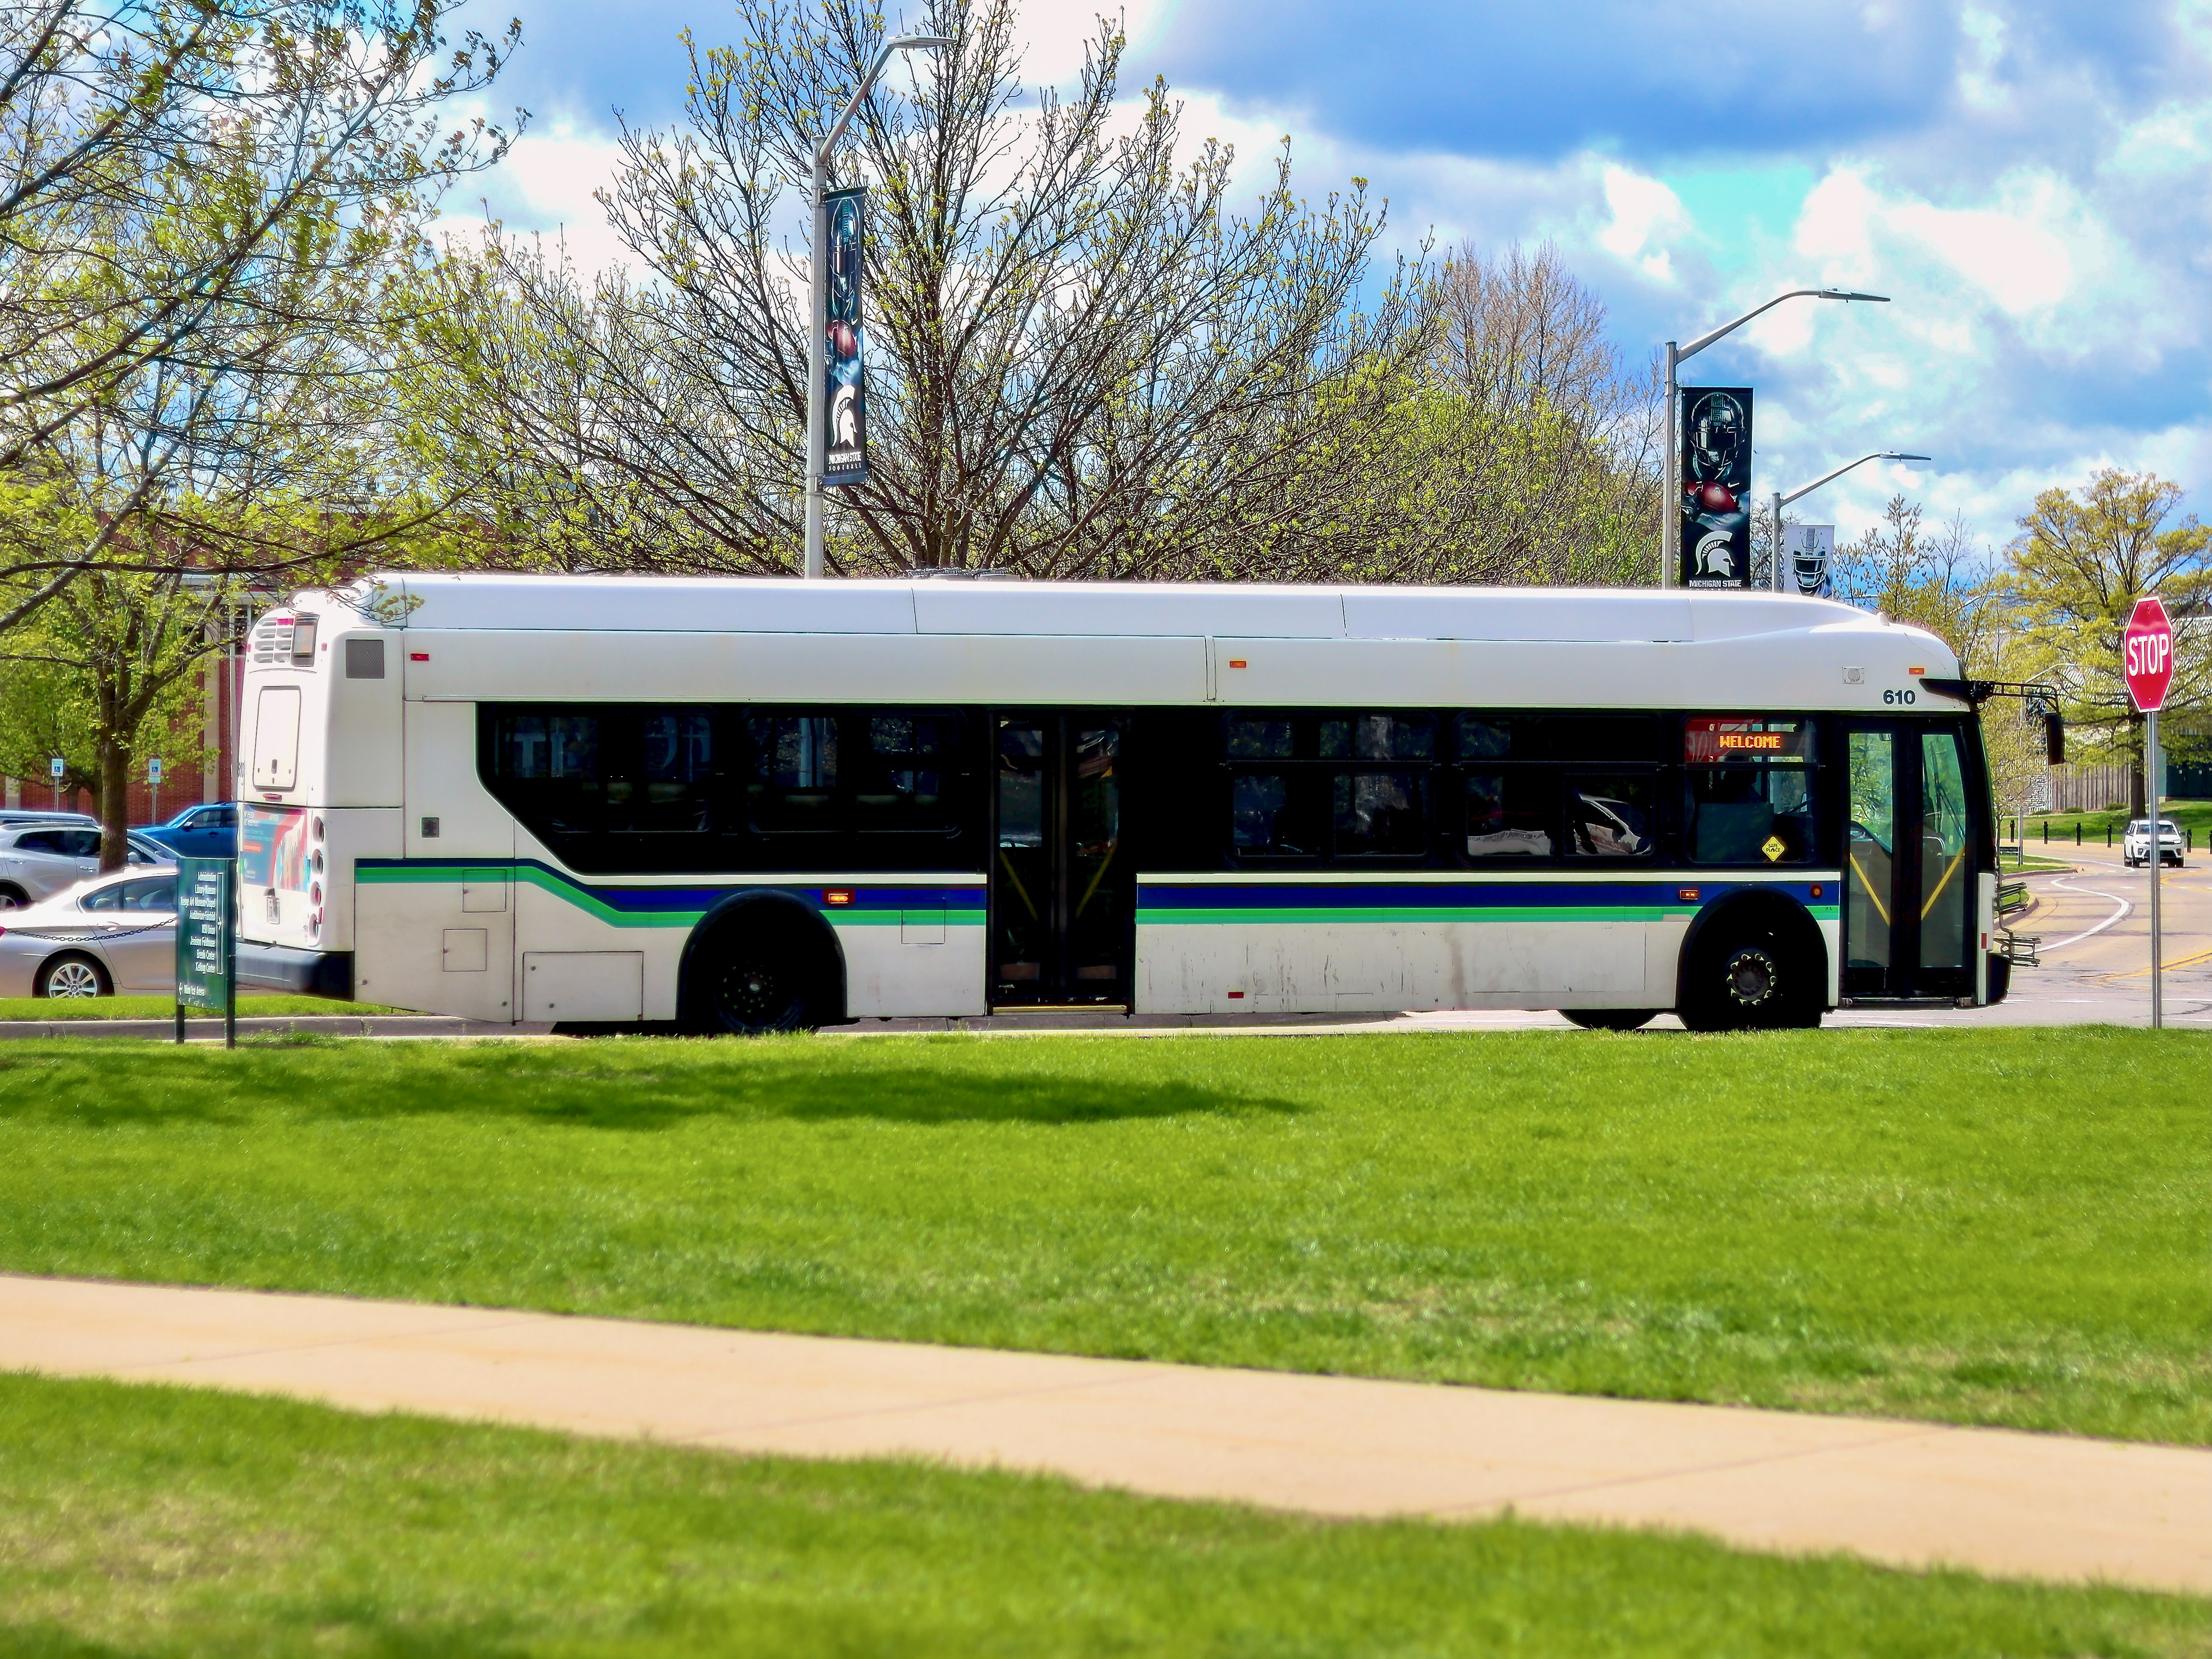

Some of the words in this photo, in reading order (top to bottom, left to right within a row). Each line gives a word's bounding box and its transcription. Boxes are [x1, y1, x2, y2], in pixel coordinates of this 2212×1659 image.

[850, 451, 861, 462] STATE
[828, 463, 861, 471] FOOTBALL
[2128, 633, 2169, 676] STOP
[1883, 689, 1916, 705] 610
[1719, 736, 1781, 748] WELCOME
